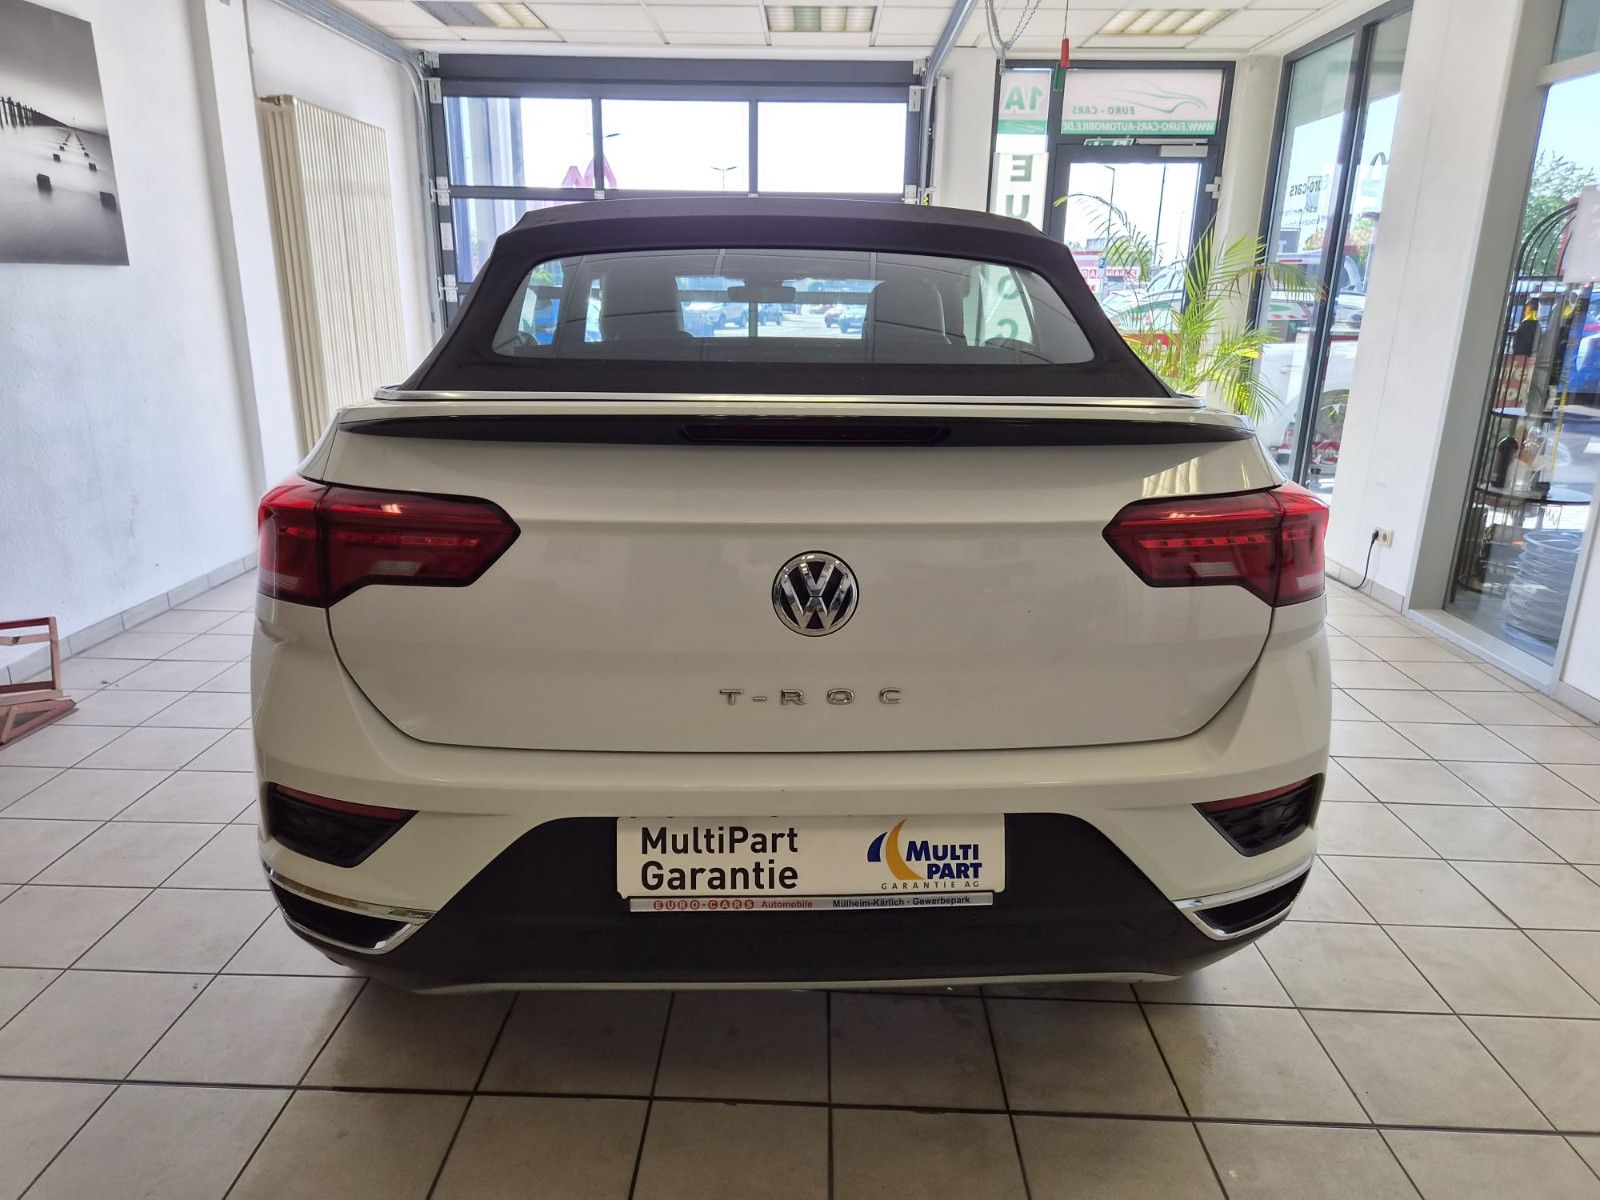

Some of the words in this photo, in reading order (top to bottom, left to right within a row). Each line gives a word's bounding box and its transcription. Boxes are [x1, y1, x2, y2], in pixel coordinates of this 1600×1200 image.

[641, 826, 798, 854] MultiPart
[906, 840, 979, 861] MULTI
[641, 858, 798, 891] Garantie
[927, 863, 982, 879] PART
[881, 881, 957, 890] GARANTIE
[964, 880, 980, 888] AG
[761, 899, 813, 909] Automobile
[832, 897, 904, 909] Mülheim-Kärlich
[912, 895, 970, 907] Gewerbepark
